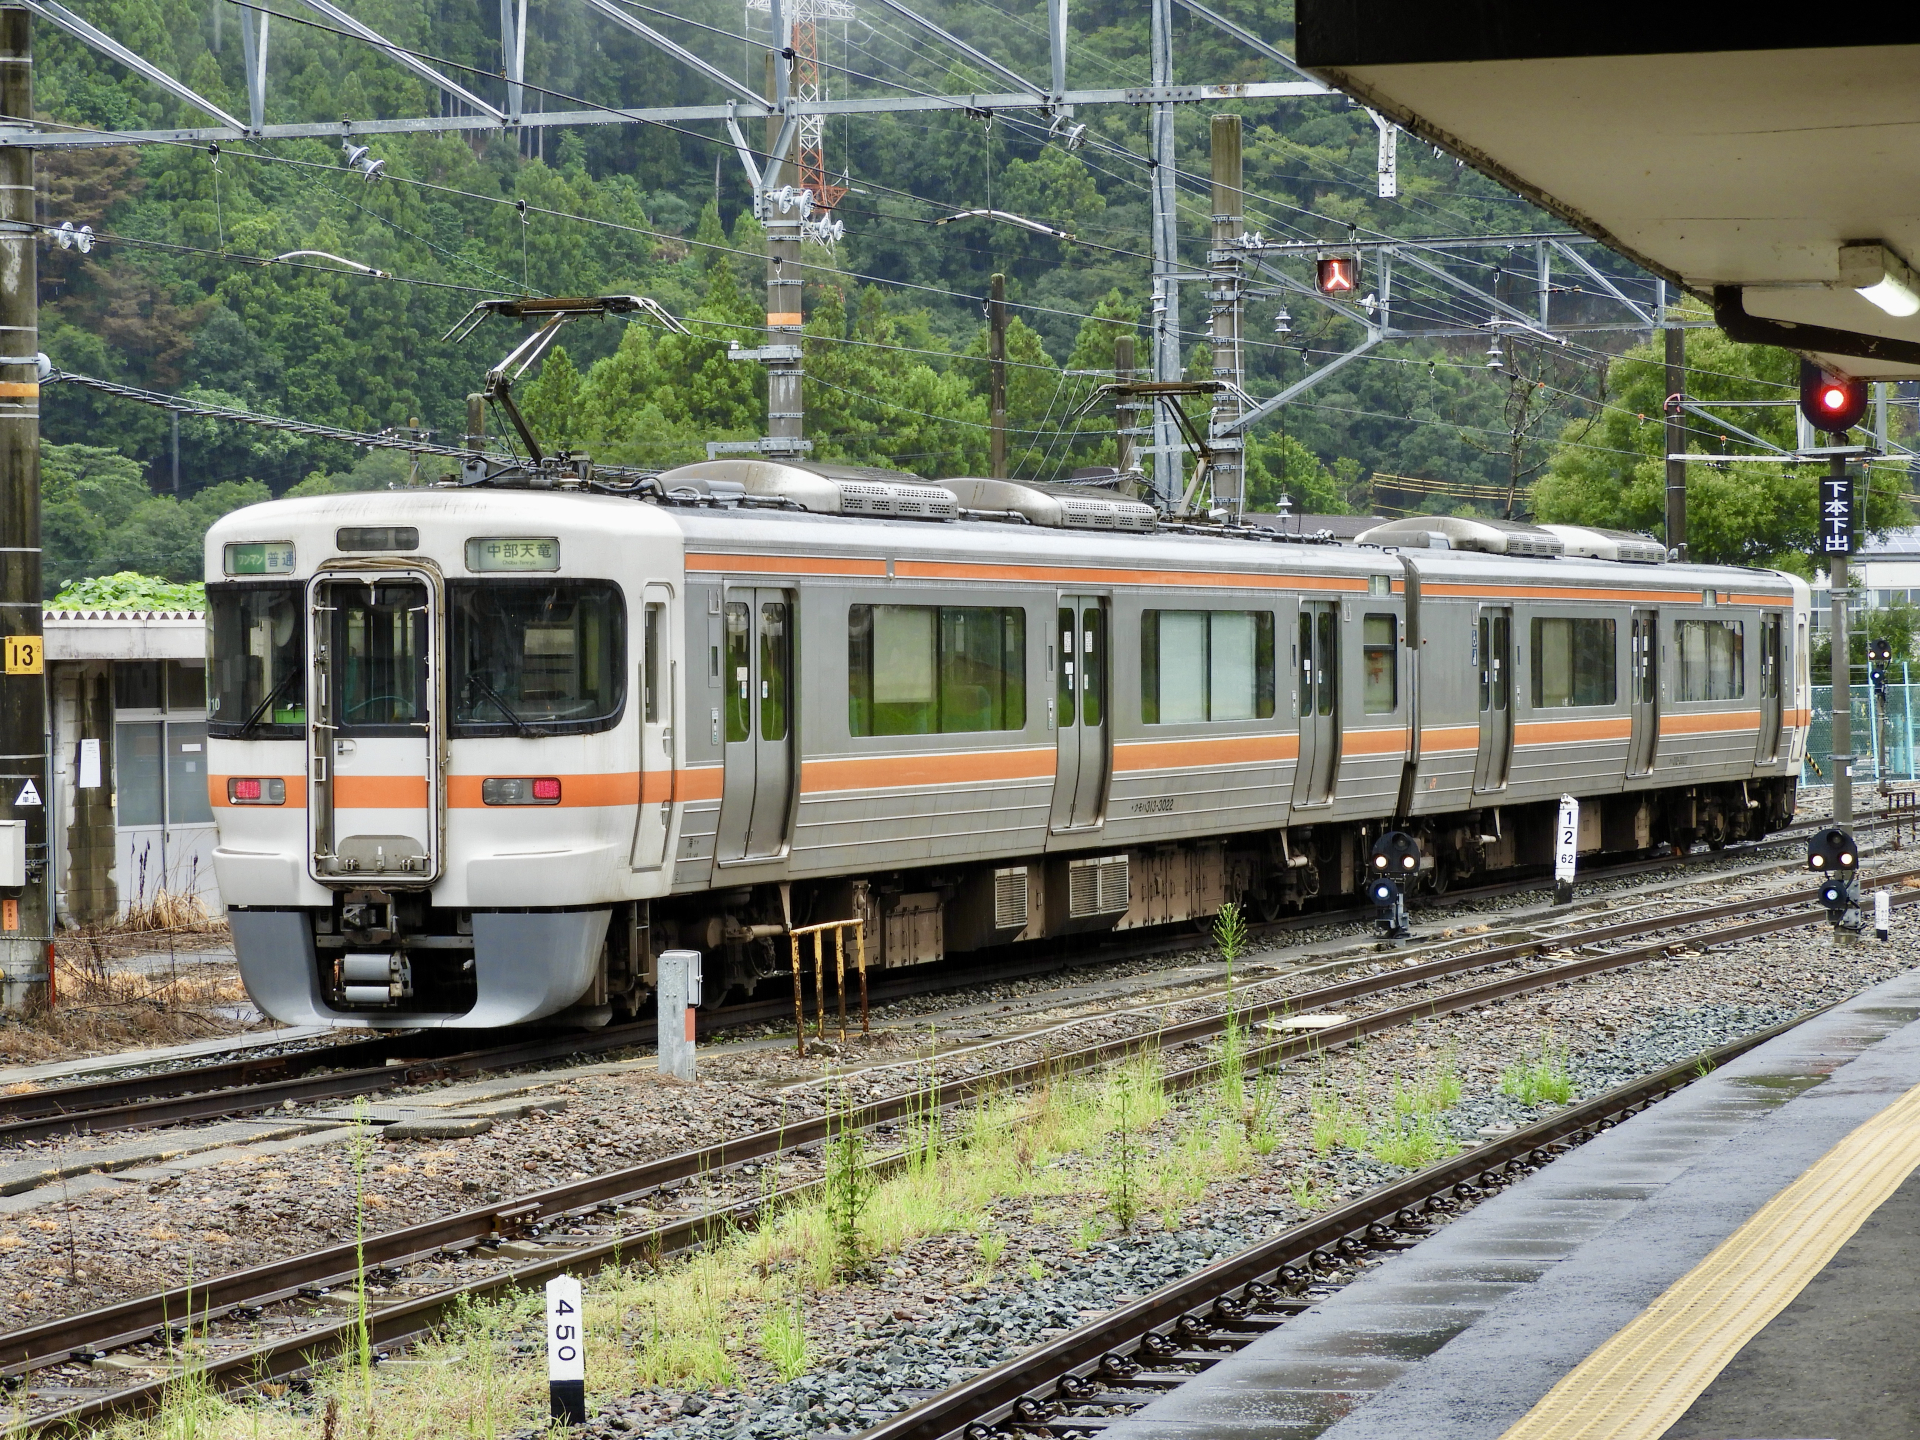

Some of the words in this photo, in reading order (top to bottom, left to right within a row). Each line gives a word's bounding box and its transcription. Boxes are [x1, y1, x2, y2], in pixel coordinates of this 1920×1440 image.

[1824, 481, 1849, 552] 下本下出
[487, 543, 552, 558] 中部天竜
[236, 554, 264, 565] ワンマン
[267, 551, 294, 567] 普通
[14, 644, 33, 666] 13
[1566, 811, 1572, 825] 1
[1564, 830, 1573, 845] 2
[1561, 854, 1574, 864] 62
[555, 1299, 576, 1361] 450
